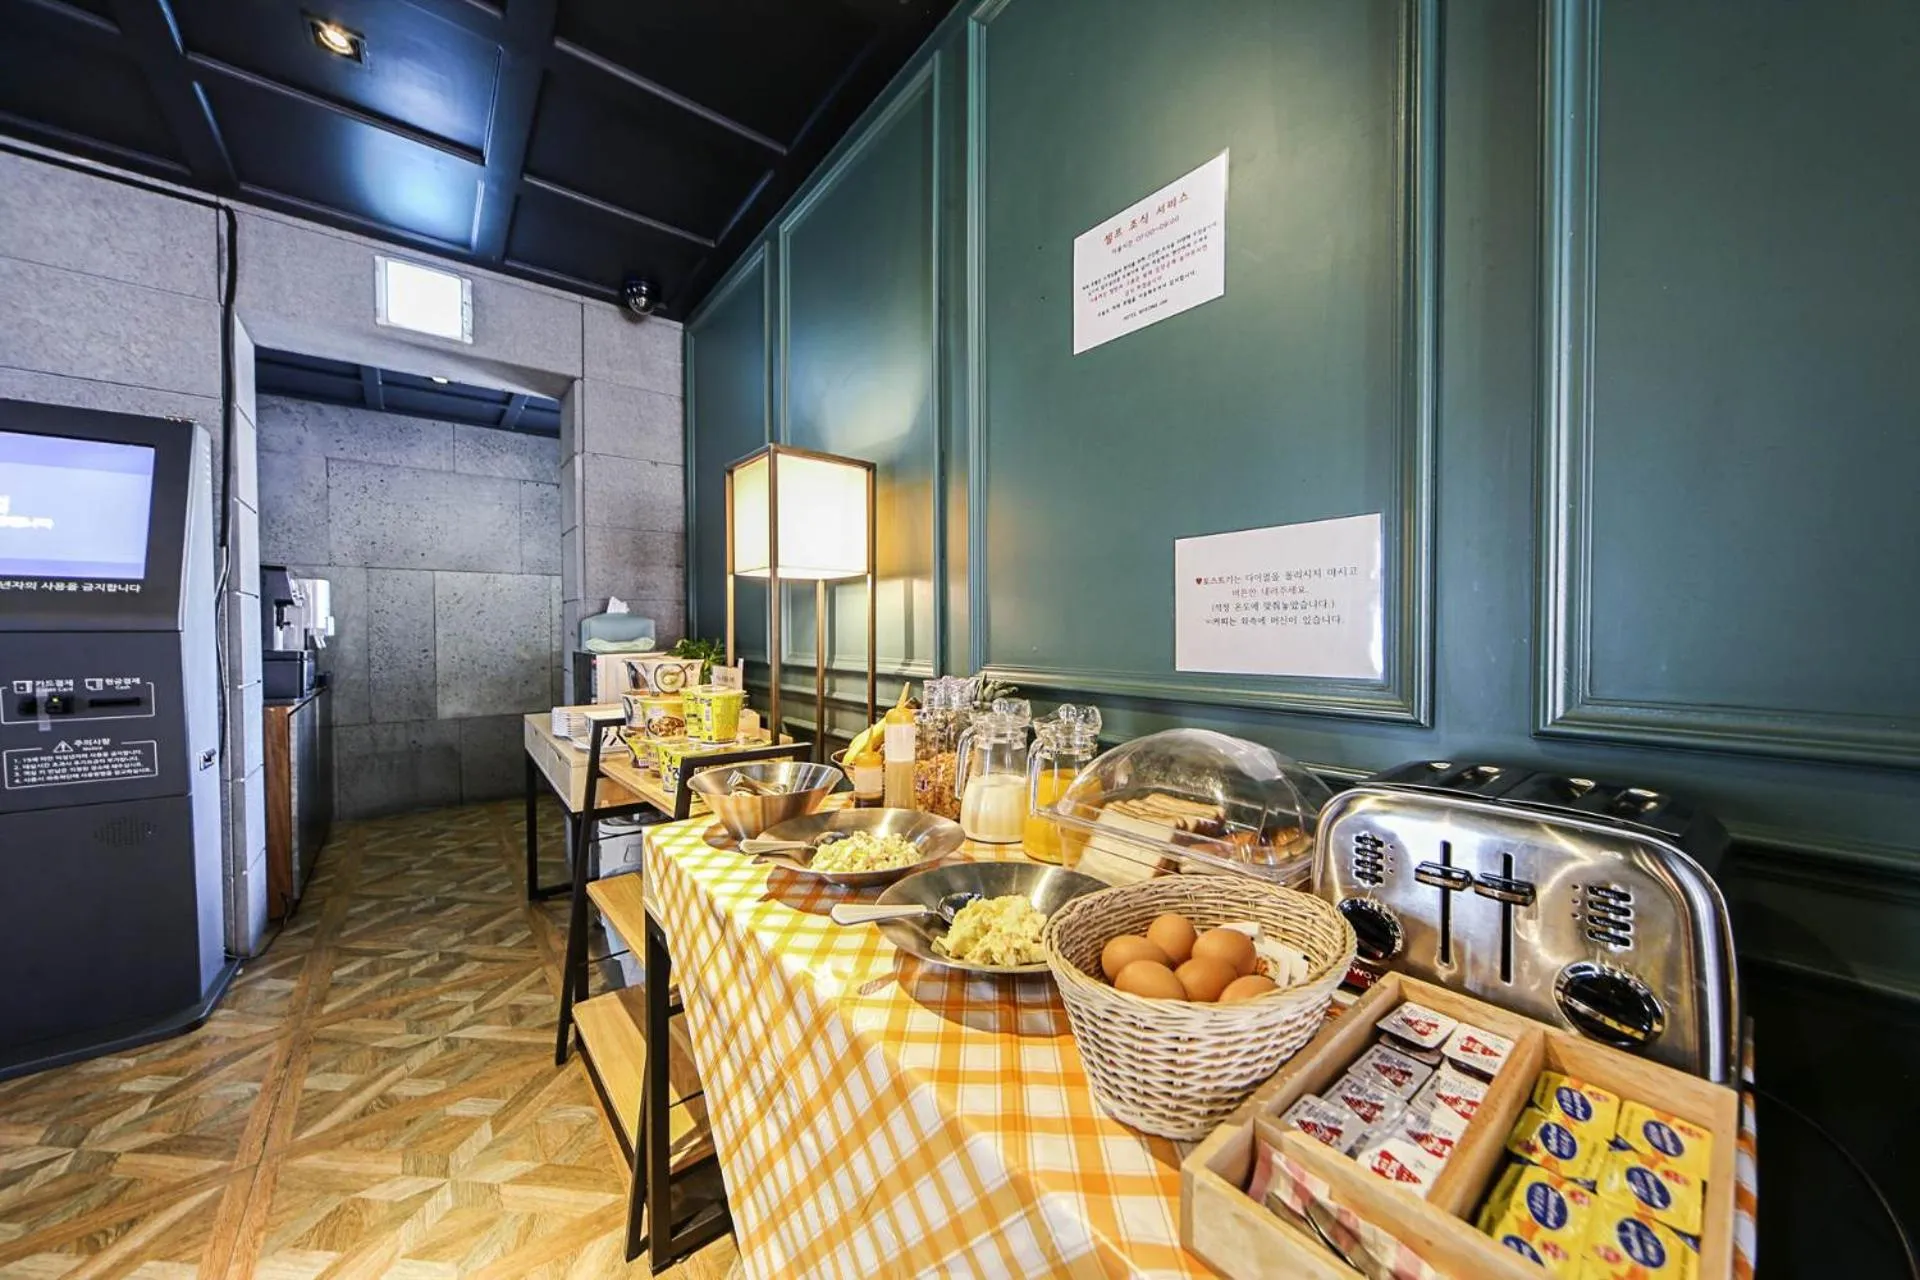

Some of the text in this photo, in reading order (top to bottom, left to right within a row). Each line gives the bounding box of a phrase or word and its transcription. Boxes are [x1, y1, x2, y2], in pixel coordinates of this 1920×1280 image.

[1129, 212, 1149, 231] 조식
[1156, 191, 1189, 215] 서비스
[1245, 571, 1280, 583] 다이얼을
[1285, 567, 1321, 580] 돌리시지
[1326, 566, 1358, 578] 마시고
[41, 581, 79, 592] 사용을
[81, 582, 142, 593] 금지합니다
[1232, 587, 1257, 598] 버튼만
[1234, 601, 1259, 612] 온도에
[1270, 615, 1298, 626] 머신이
[105, 677, 141, 686] 현금결제
[74, 738, 111, 747] 주의사항
